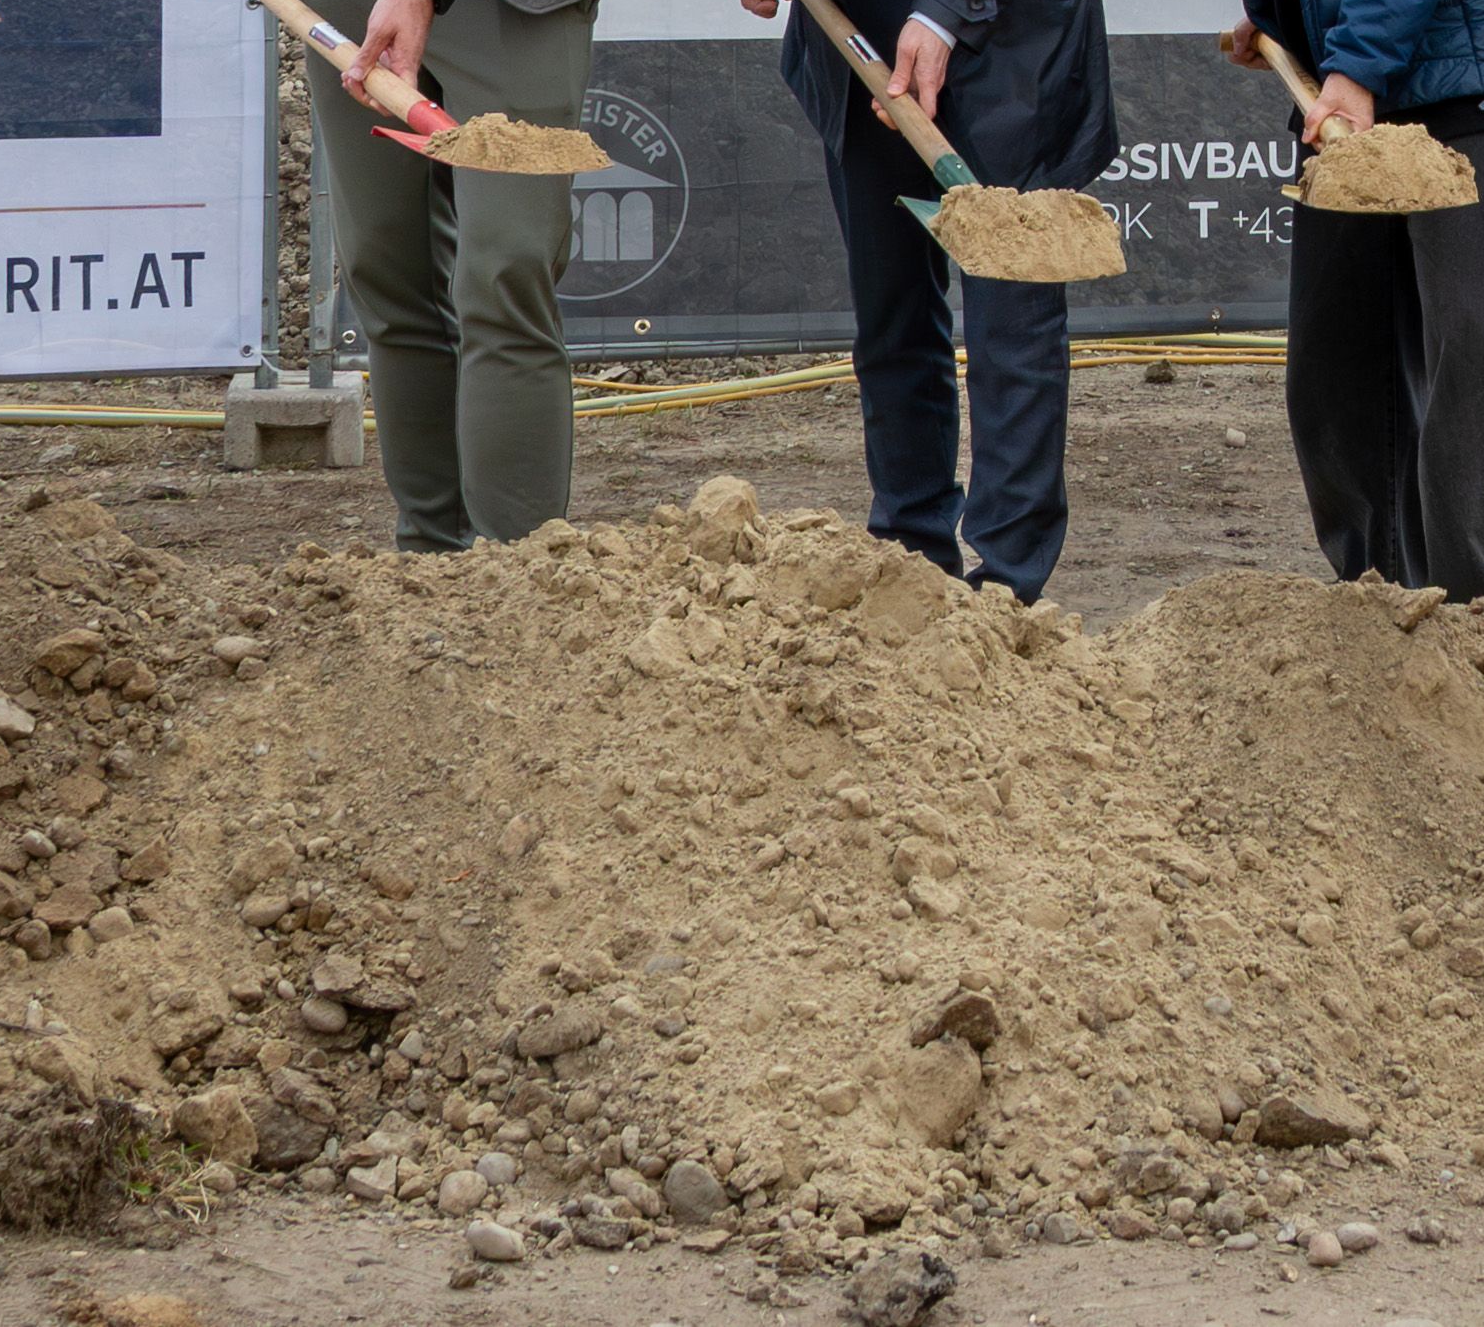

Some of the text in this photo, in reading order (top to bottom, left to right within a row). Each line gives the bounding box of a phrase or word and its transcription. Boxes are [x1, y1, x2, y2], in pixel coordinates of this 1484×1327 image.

[581, 99, 667, 165] EISTER
[1098, 140, 1297, 182] SSIVBAU
[1188, 201, 1219, 238] T
